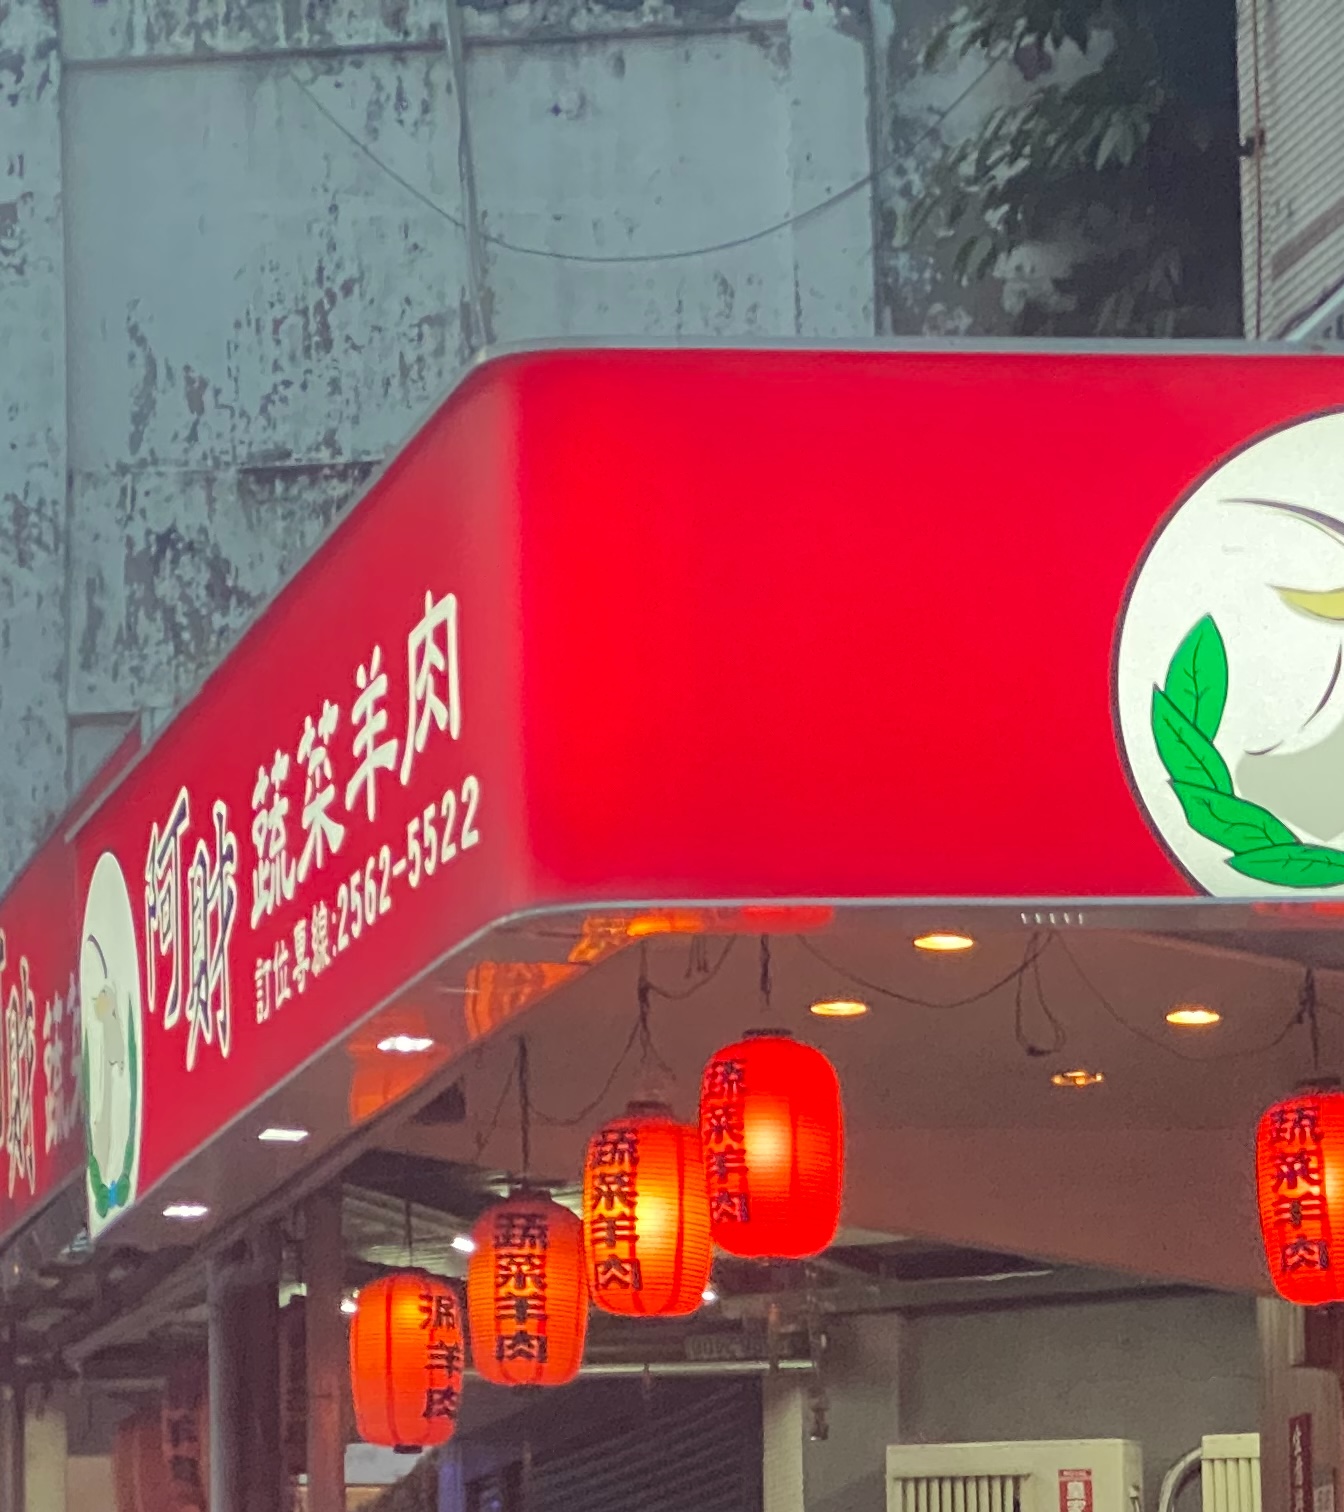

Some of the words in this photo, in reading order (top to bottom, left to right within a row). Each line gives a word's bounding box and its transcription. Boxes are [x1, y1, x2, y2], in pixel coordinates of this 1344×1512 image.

[144, 785, 238, 1073] 阿財
[250, 588, 461, 931] 蔬菜羊肉
[590, 1128, 643, 1292] 蔬菜羊肉
[1268, 1104, 1331, 1272] 蔬菜羊肉
[494, 1212, 548, 1364] 蔬菜羊肉
